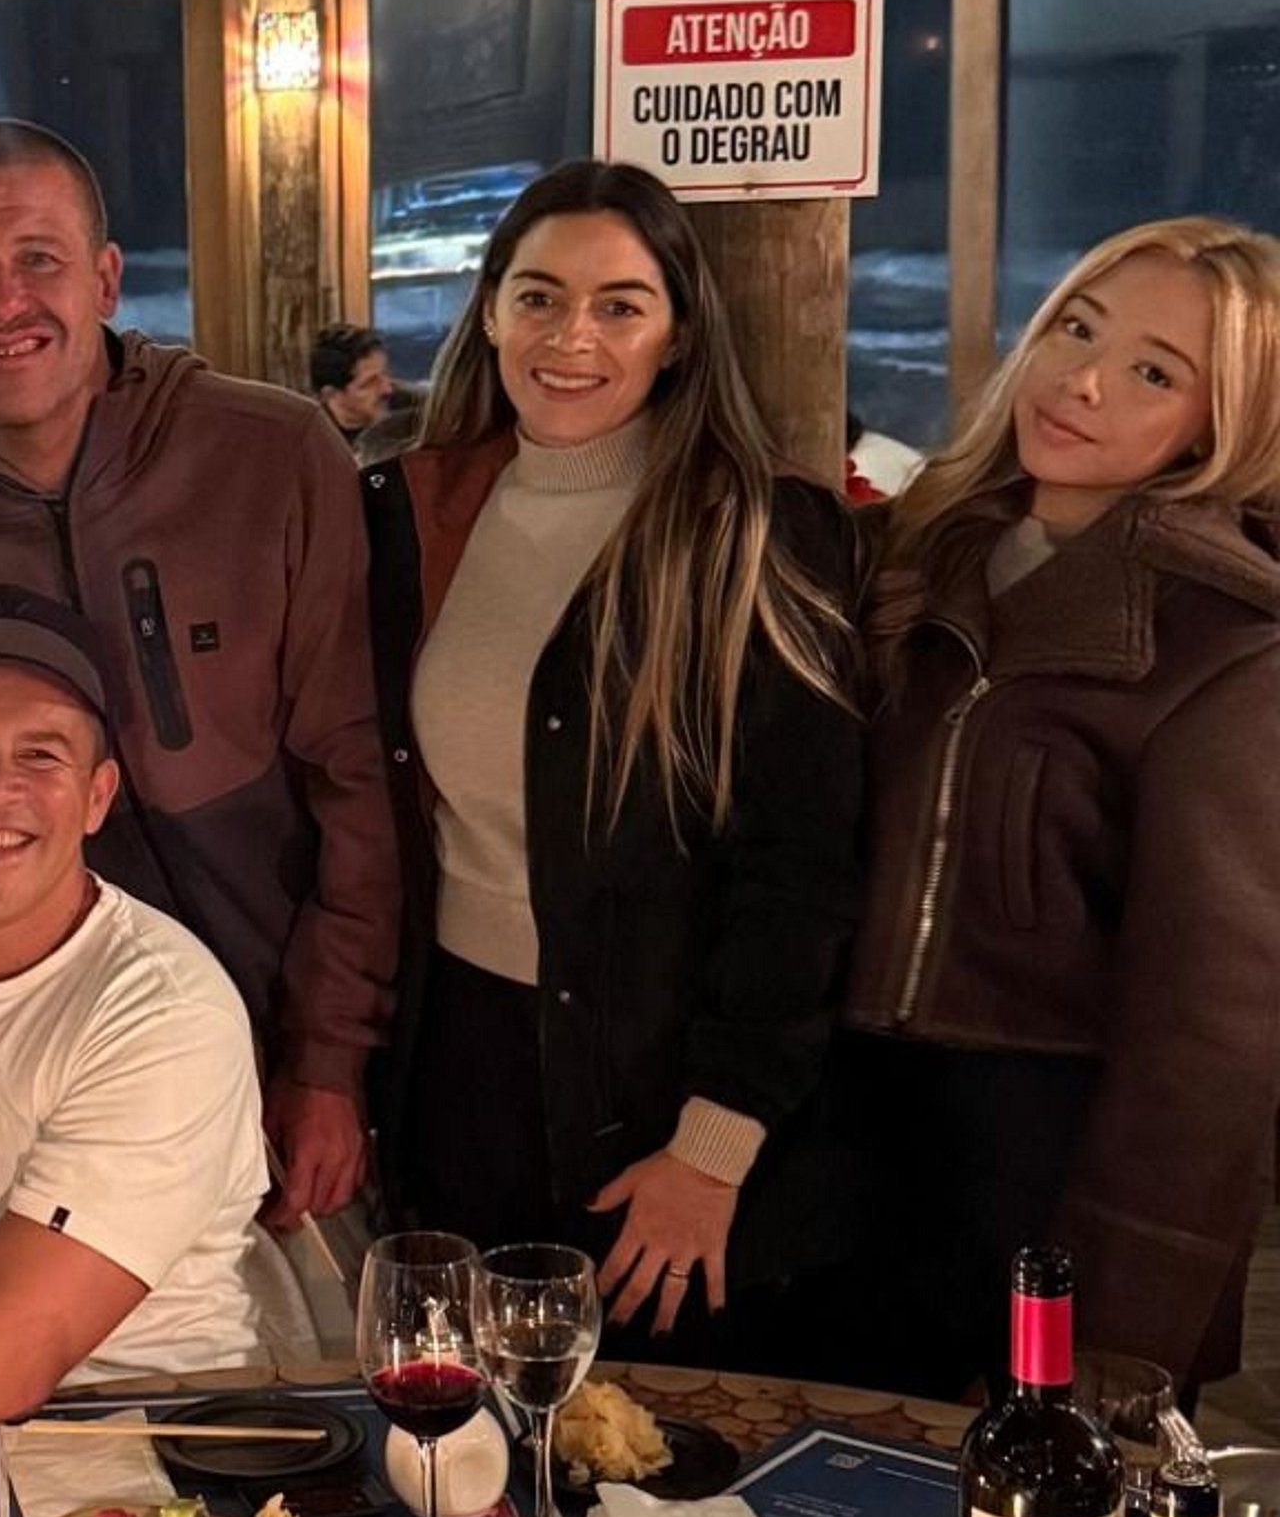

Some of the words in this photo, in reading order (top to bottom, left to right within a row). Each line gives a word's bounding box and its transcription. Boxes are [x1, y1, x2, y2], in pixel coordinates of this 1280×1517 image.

[666, 2, 810, 59] ATENÇÃO
[633, 83, 765, 124] CUIDADO
[774, 78, 842, 118] COM
[662, 128, 681, 166] O
[690, 124, 812, 165] DEGRAU
